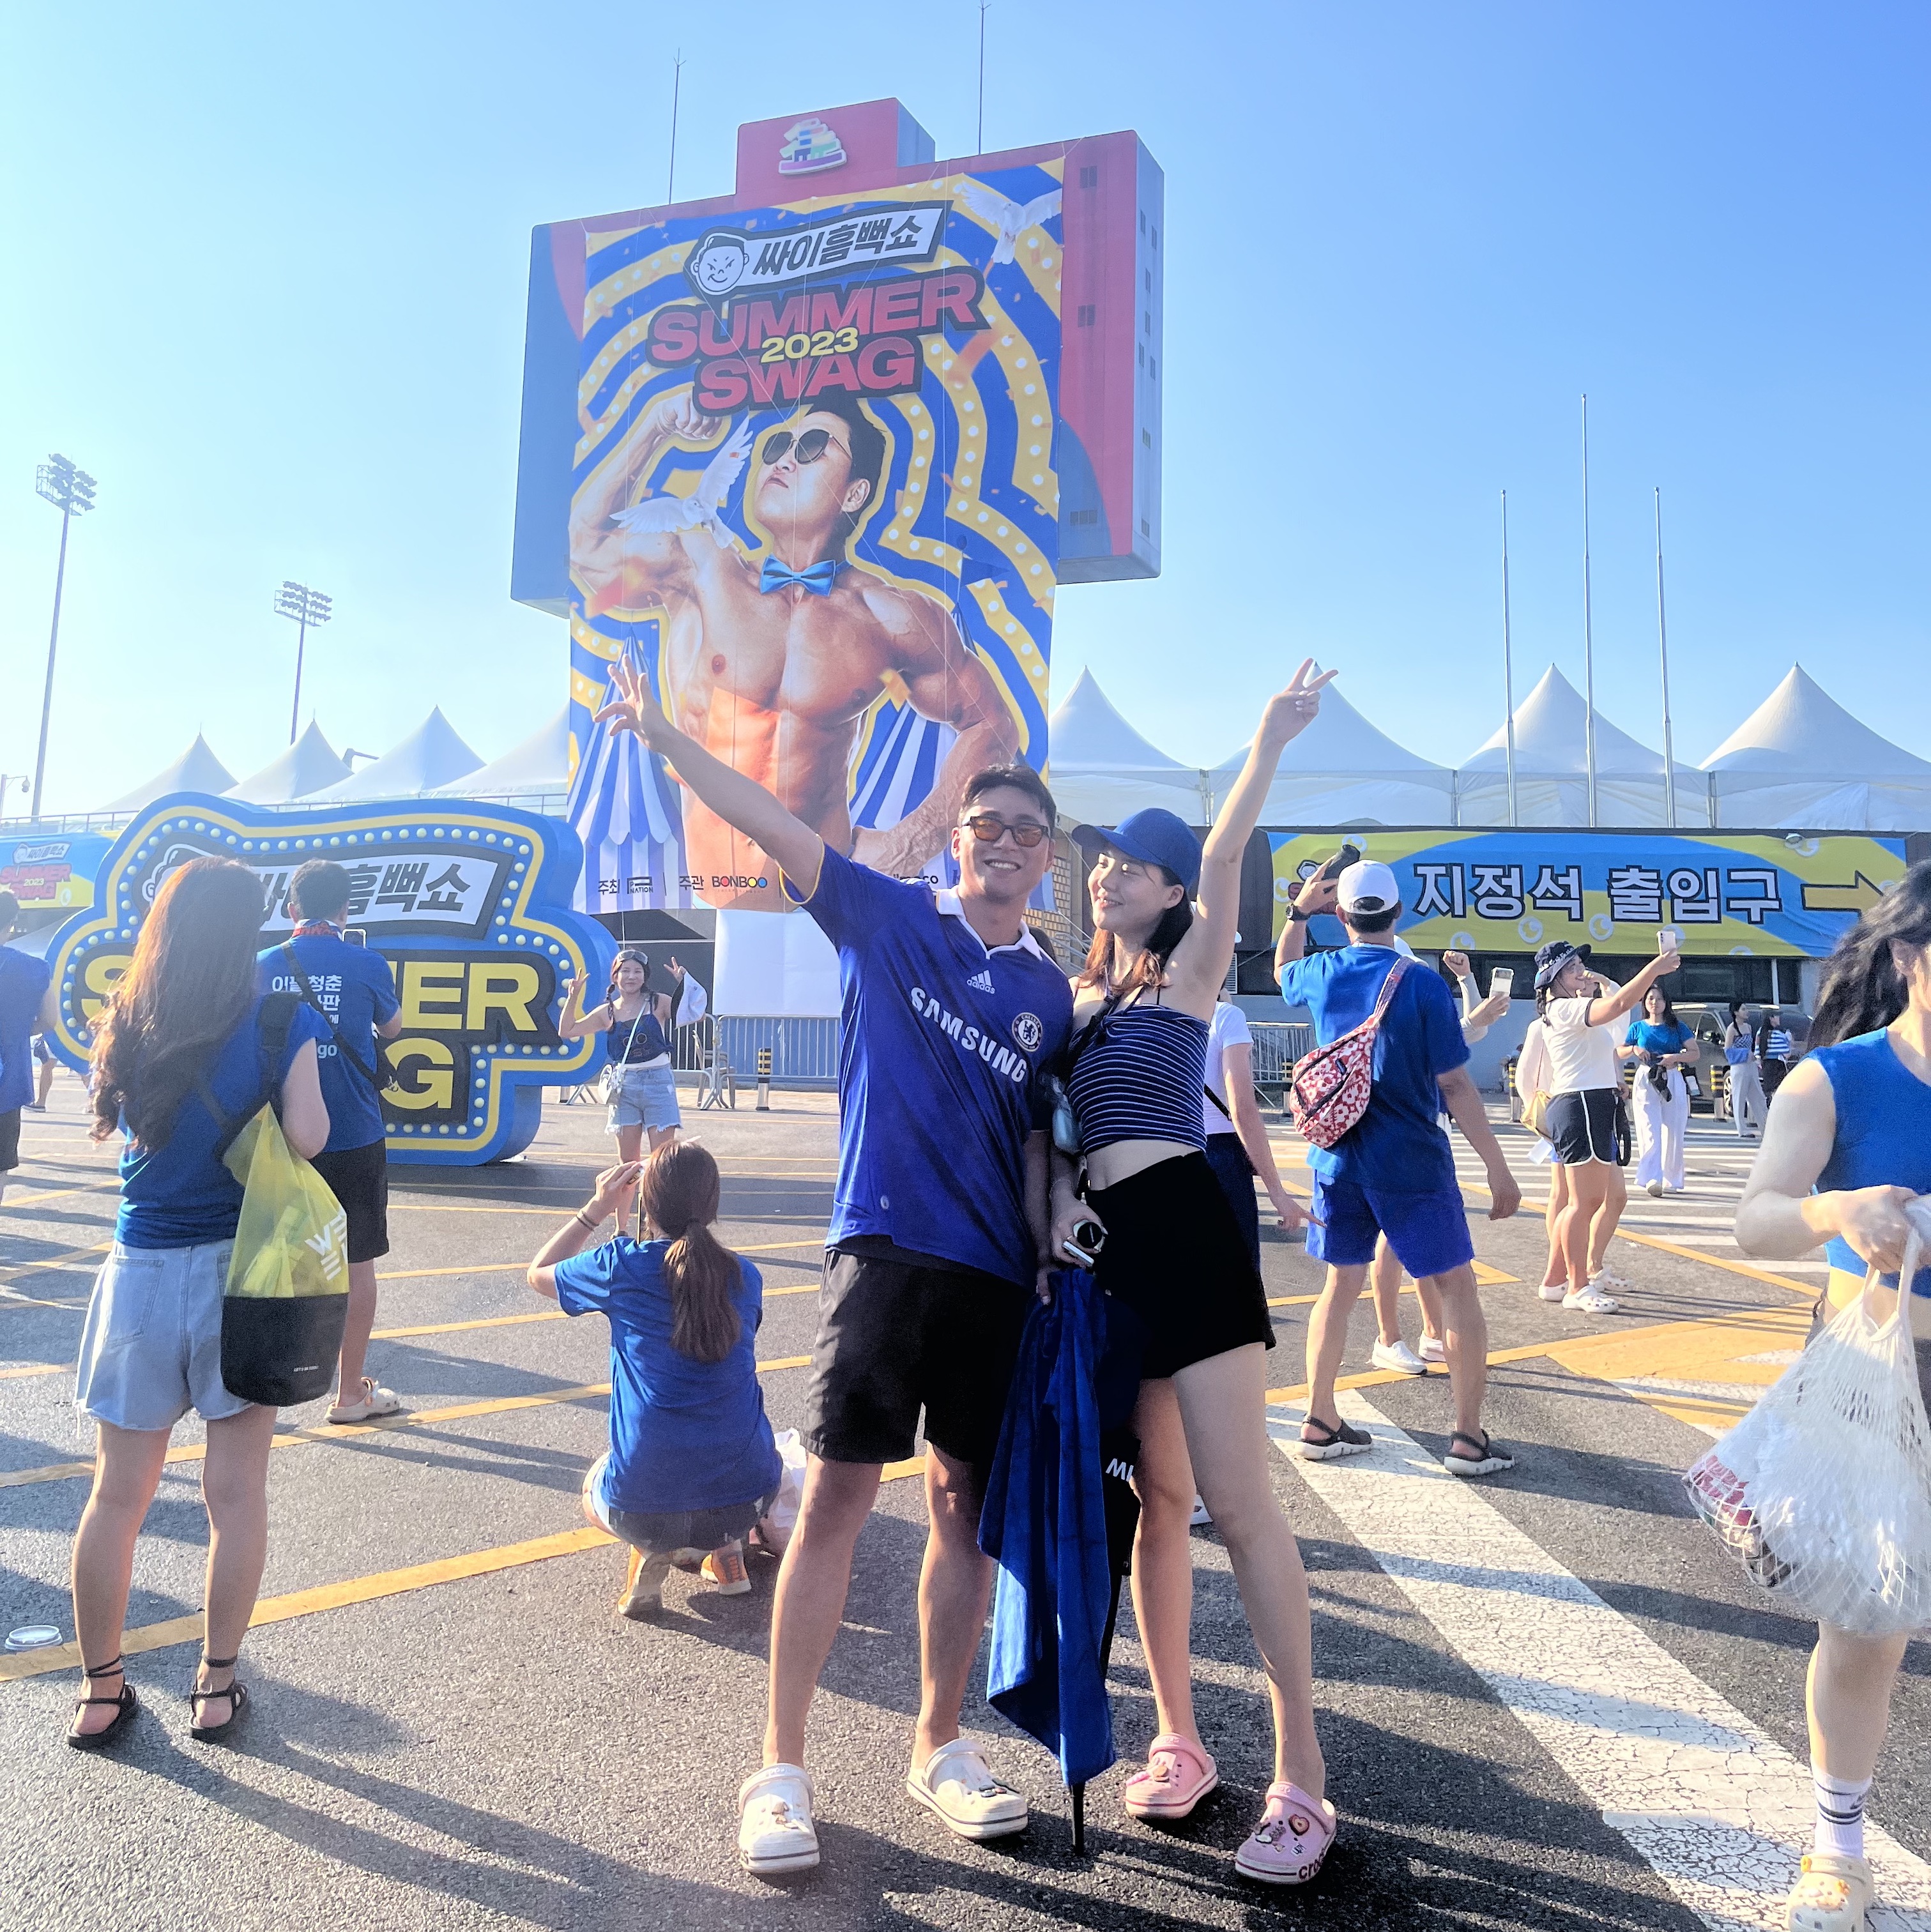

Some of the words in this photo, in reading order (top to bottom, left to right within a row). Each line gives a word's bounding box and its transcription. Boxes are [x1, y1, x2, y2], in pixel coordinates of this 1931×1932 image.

[752, 215, 922, 275] 싸이흠뻑쇼
[651, 273, 976, 361] SUMMER
[761, 328, 858, 362] 2023
[698, 336, 915, 409] SWAG
[23, 878, 45, 886] 2023
[598, 879, 620, 895] 주최
[679, 876, 704, 890] 주관
[712, 876, 767, 888] BONBOO
[1414, 864, 1583, 921] 지정석
[1608, 865, 1782, 924] 출입구
[966, 979, 995, 994] adidas
[911, 987, 1027, 1083] SAMSUNG
